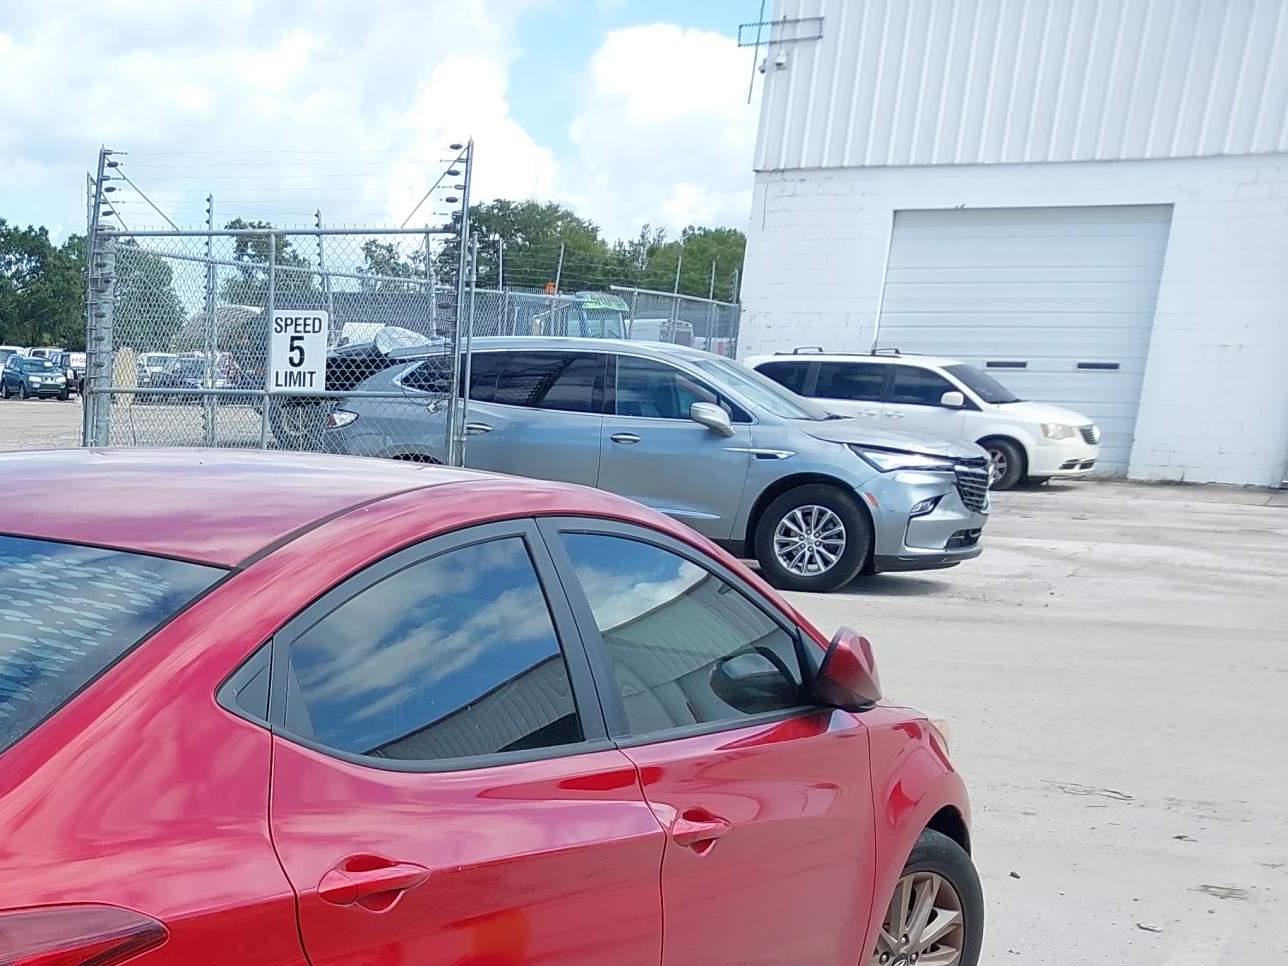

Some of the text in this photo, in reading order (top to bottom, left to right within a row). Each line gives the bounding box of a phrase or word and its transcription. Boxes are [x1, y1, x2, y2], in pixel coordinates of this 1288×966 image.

[274, 316, 322, 334] SPEED
[288, 335, 305, 368] 5
[275, 370, 316, 388] LIMIT
